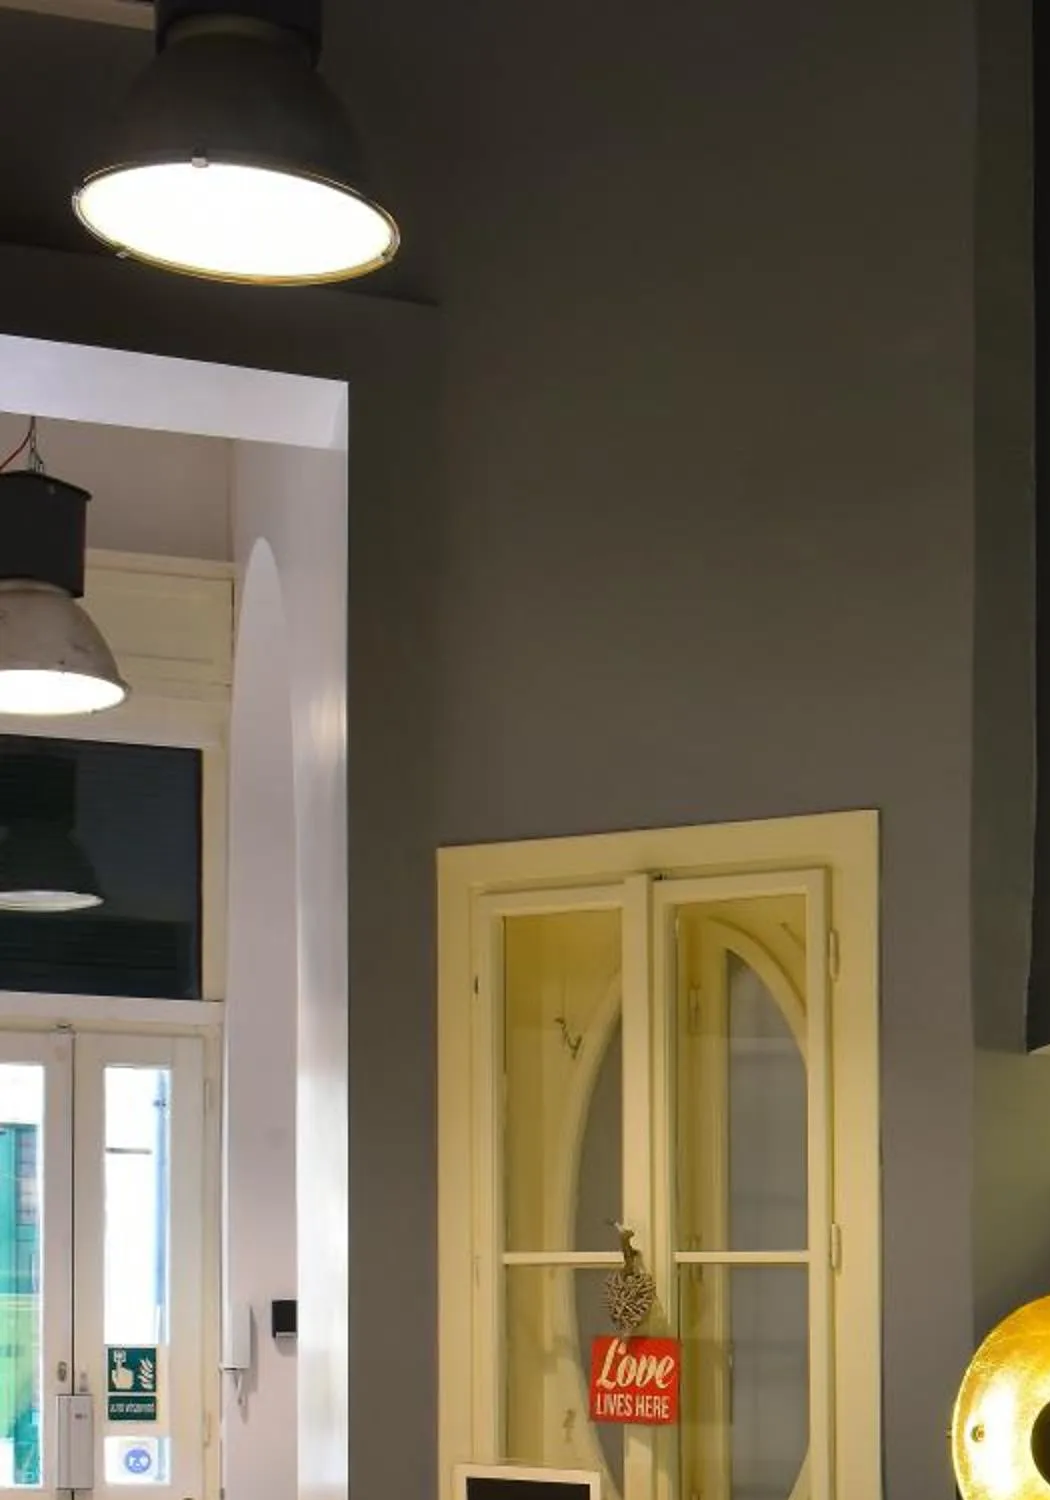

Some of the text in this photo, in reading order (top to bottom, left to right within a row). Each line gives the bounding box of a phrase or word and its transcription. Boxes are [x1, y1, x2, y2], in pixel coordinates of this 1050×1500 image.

[596, 1338, 675, 1390] Love
[596, 1393, 670, 1419] LIVES HERE
